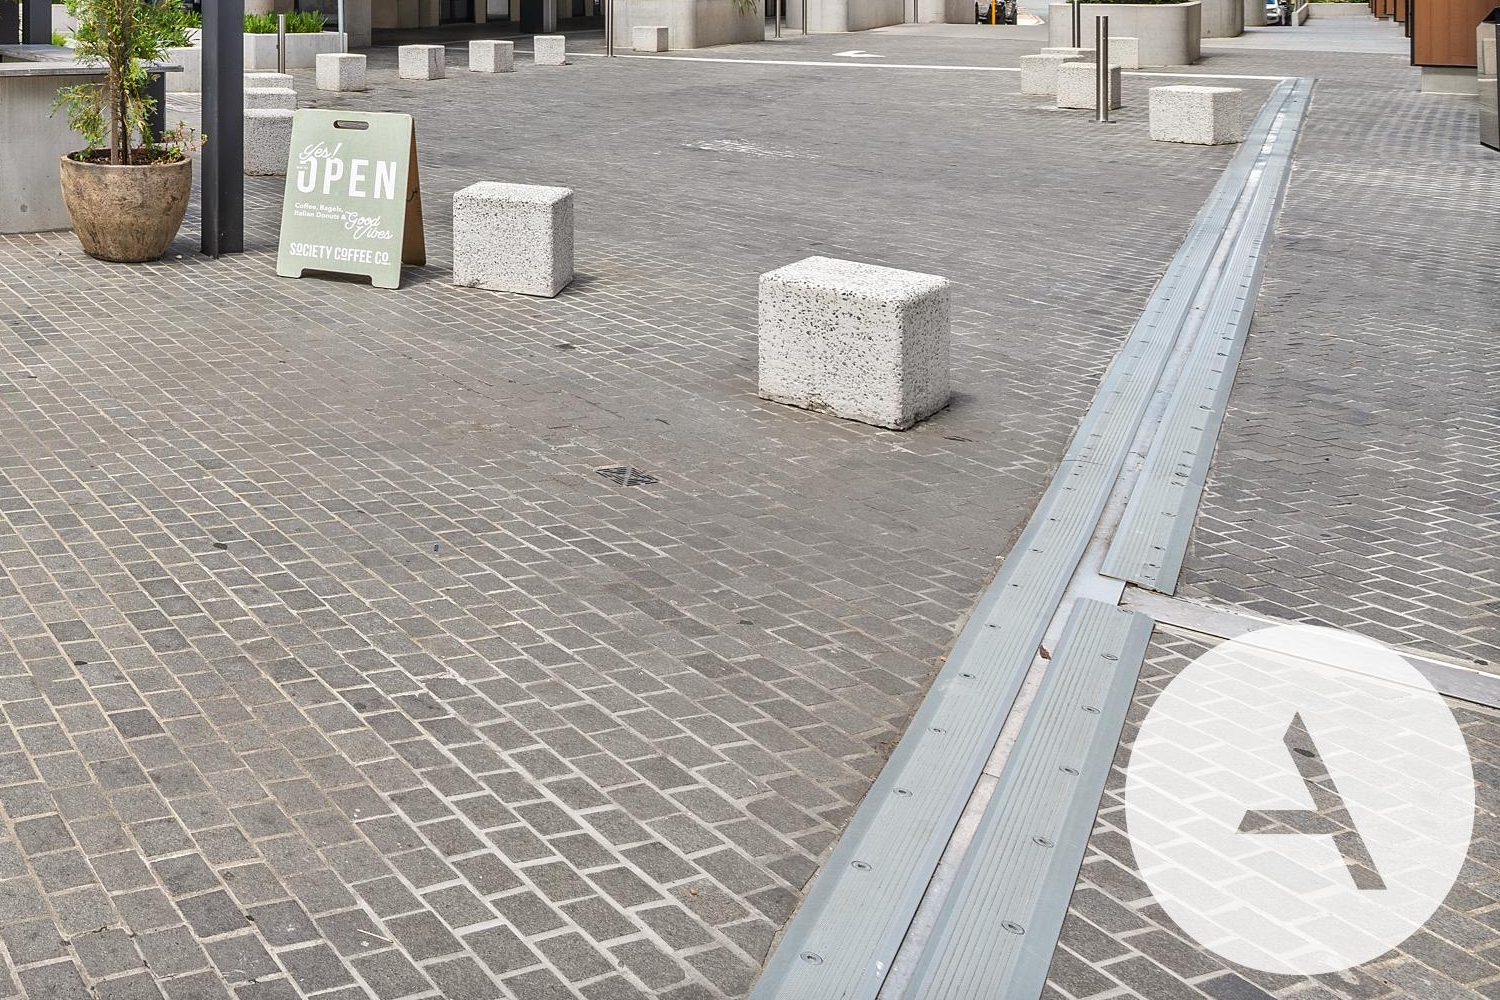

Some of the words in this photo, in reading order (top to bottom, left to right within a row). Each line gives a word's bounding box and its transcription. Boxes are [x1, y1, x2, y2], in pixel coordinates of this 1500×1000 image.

[299, 141, 342, 160] Yes!
[297, 156, 397, 200] OPEN
[294, 202, 318, 211] Coffee,
[320, 204, 343, 213] Bagels,
[316, 212, 339, 220] Donuts
[345, 211, 381, 229] Good
[353, 223, 393, 240] Vibes
[289, 242, 333, 259] SOCIETY
[334, 247, 373, 264] COFFEE
